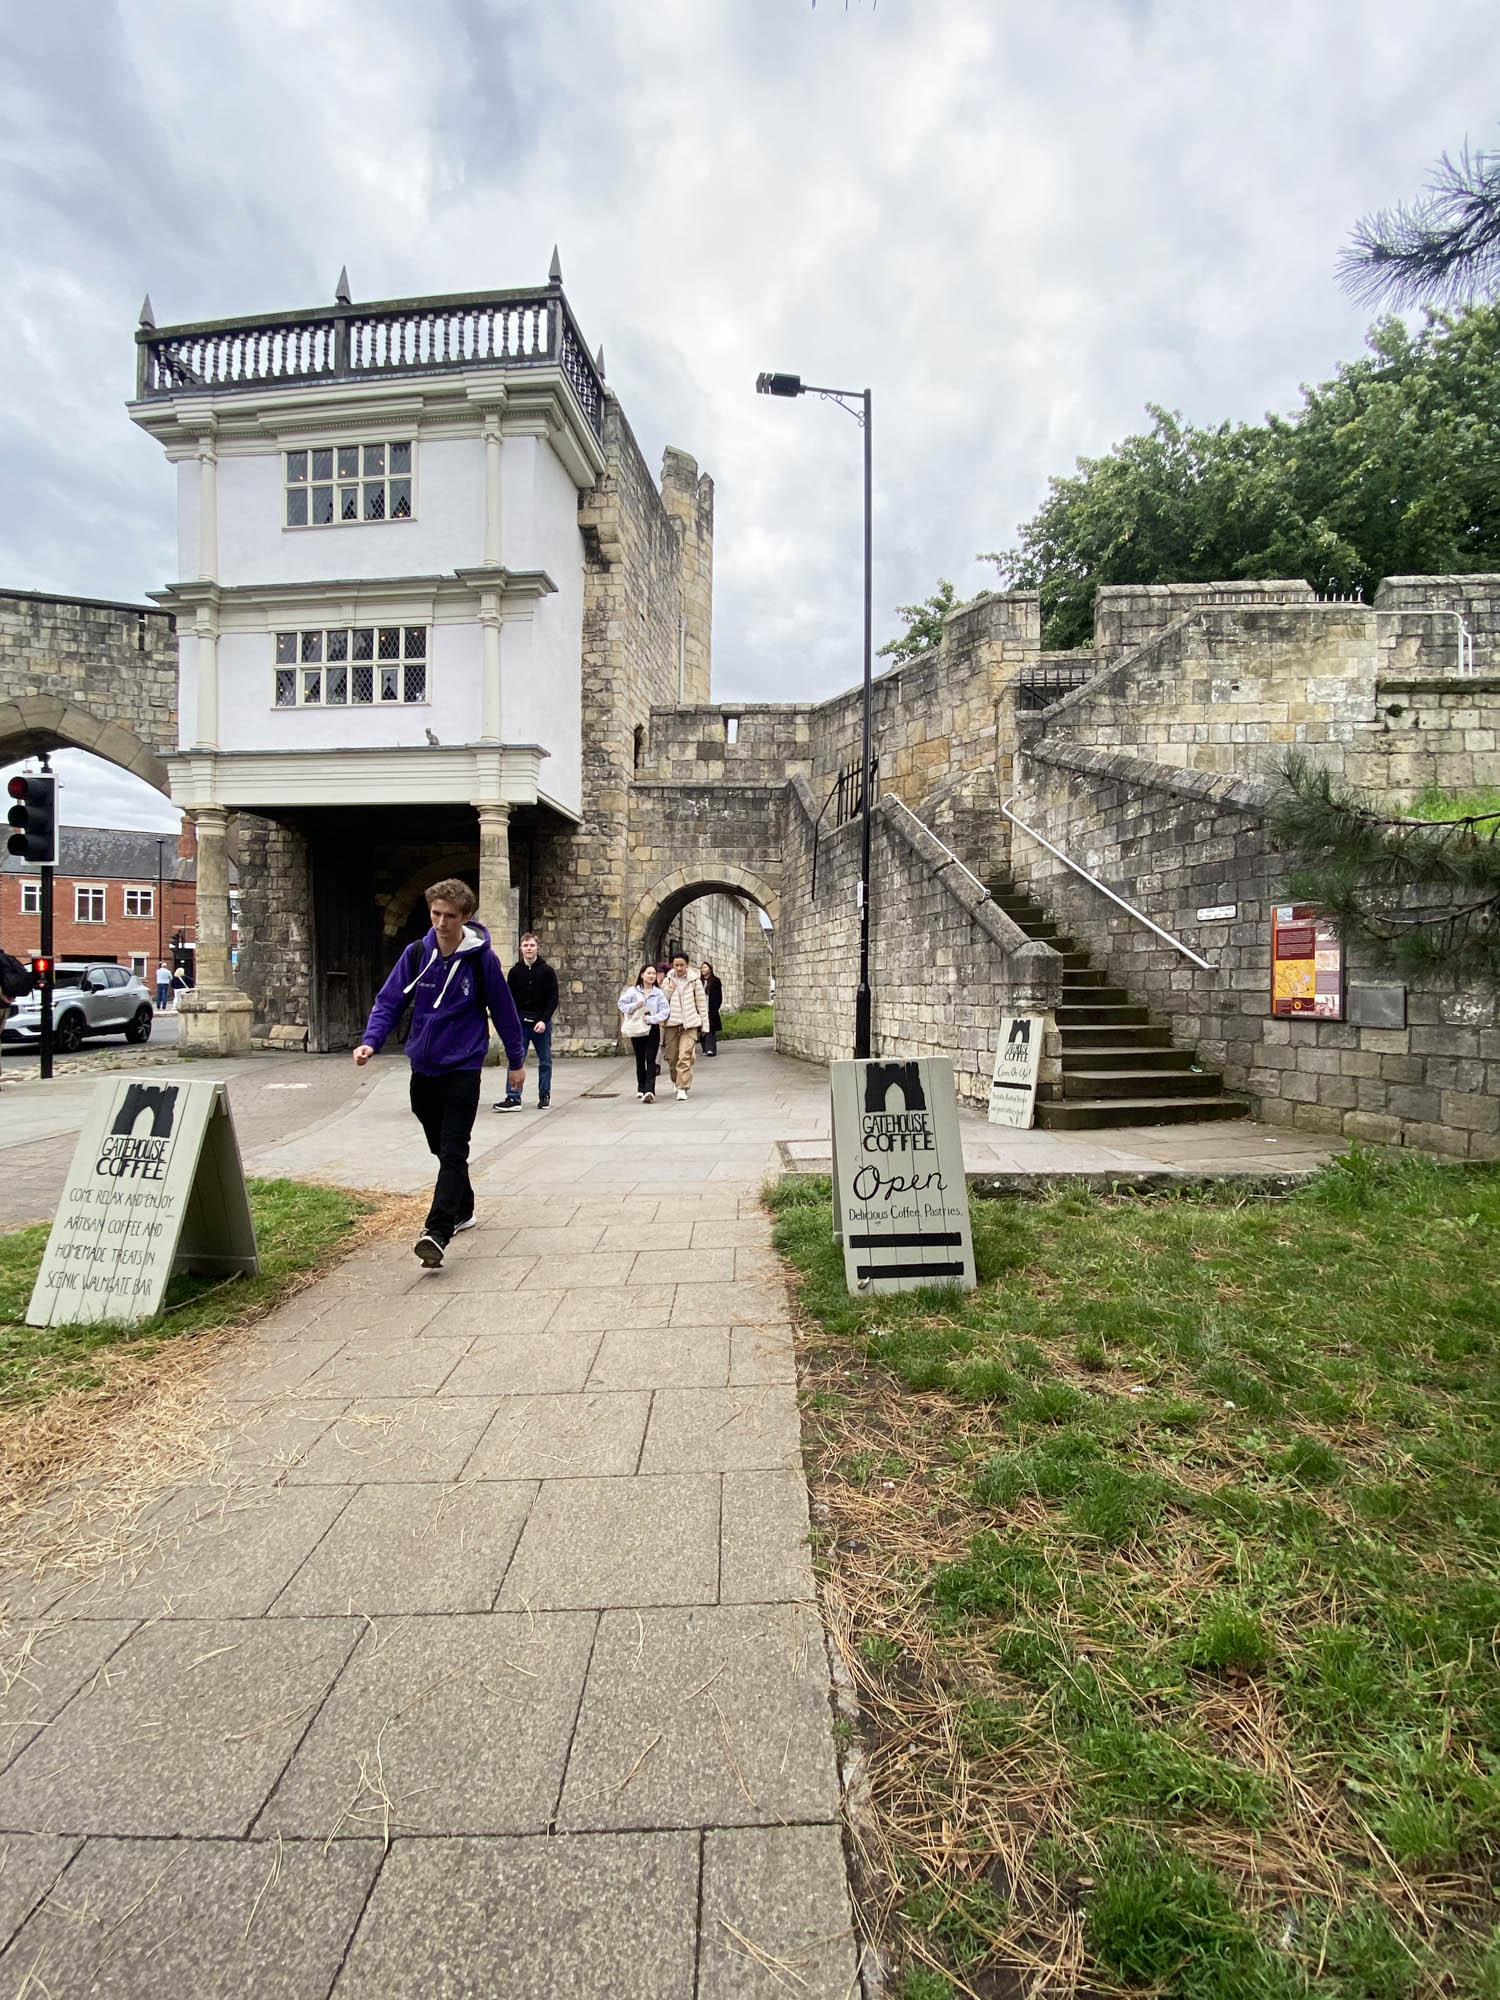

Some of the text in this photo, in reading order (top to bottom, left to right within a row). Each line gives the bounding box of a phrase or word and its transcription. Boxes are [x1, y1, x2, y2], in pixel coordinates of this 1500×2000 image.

[862, 1113, 930, 1134] GATEHOUSE
[102, 1136, 170, 1161] GATEHOUSE
[863, 1132, 936, 1152] COFFEE
[96, 1156, 167, 1180] COFFEE
[853, 1164, 948, 1201] Open
[69, 1187, 175, 1209] COME RELAX AND ENJOY
[849, 1208, 888, 1220] Delicious
[63, 1215, 163, 1237] ARTISAN COFFEE AND
[55, 1243, 155, 1266] HOMEMADE TREATS IN
[45, 1270, 153, 1296] SCENIC WALMGATE BAR
